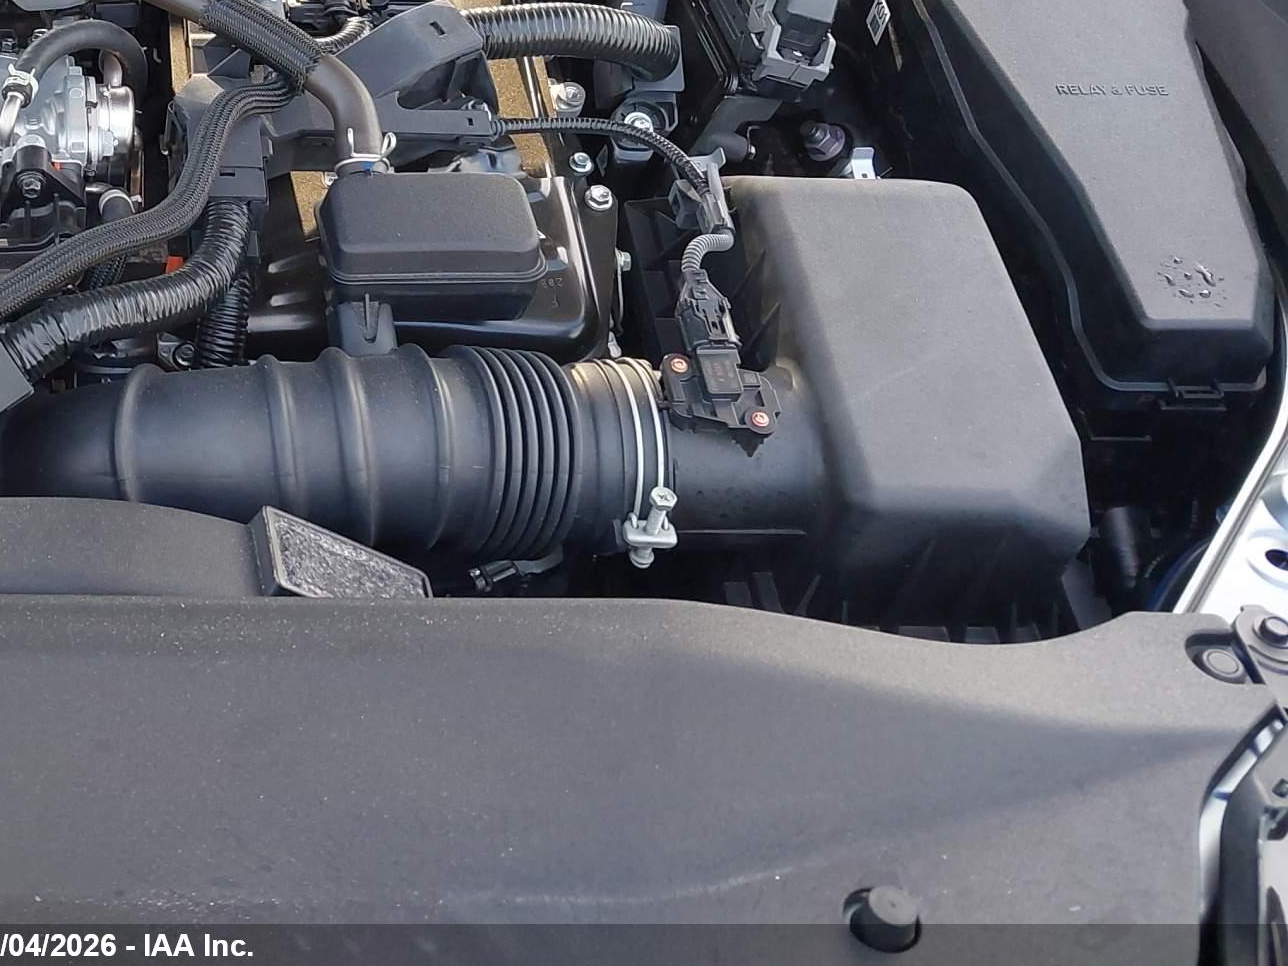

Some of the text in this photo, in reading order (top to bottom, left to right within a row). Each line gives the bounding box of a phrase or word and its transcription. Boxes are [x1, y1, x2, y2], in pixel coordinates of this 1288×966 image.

[1055, 82, 1169, 96] RELAY & FUSE
